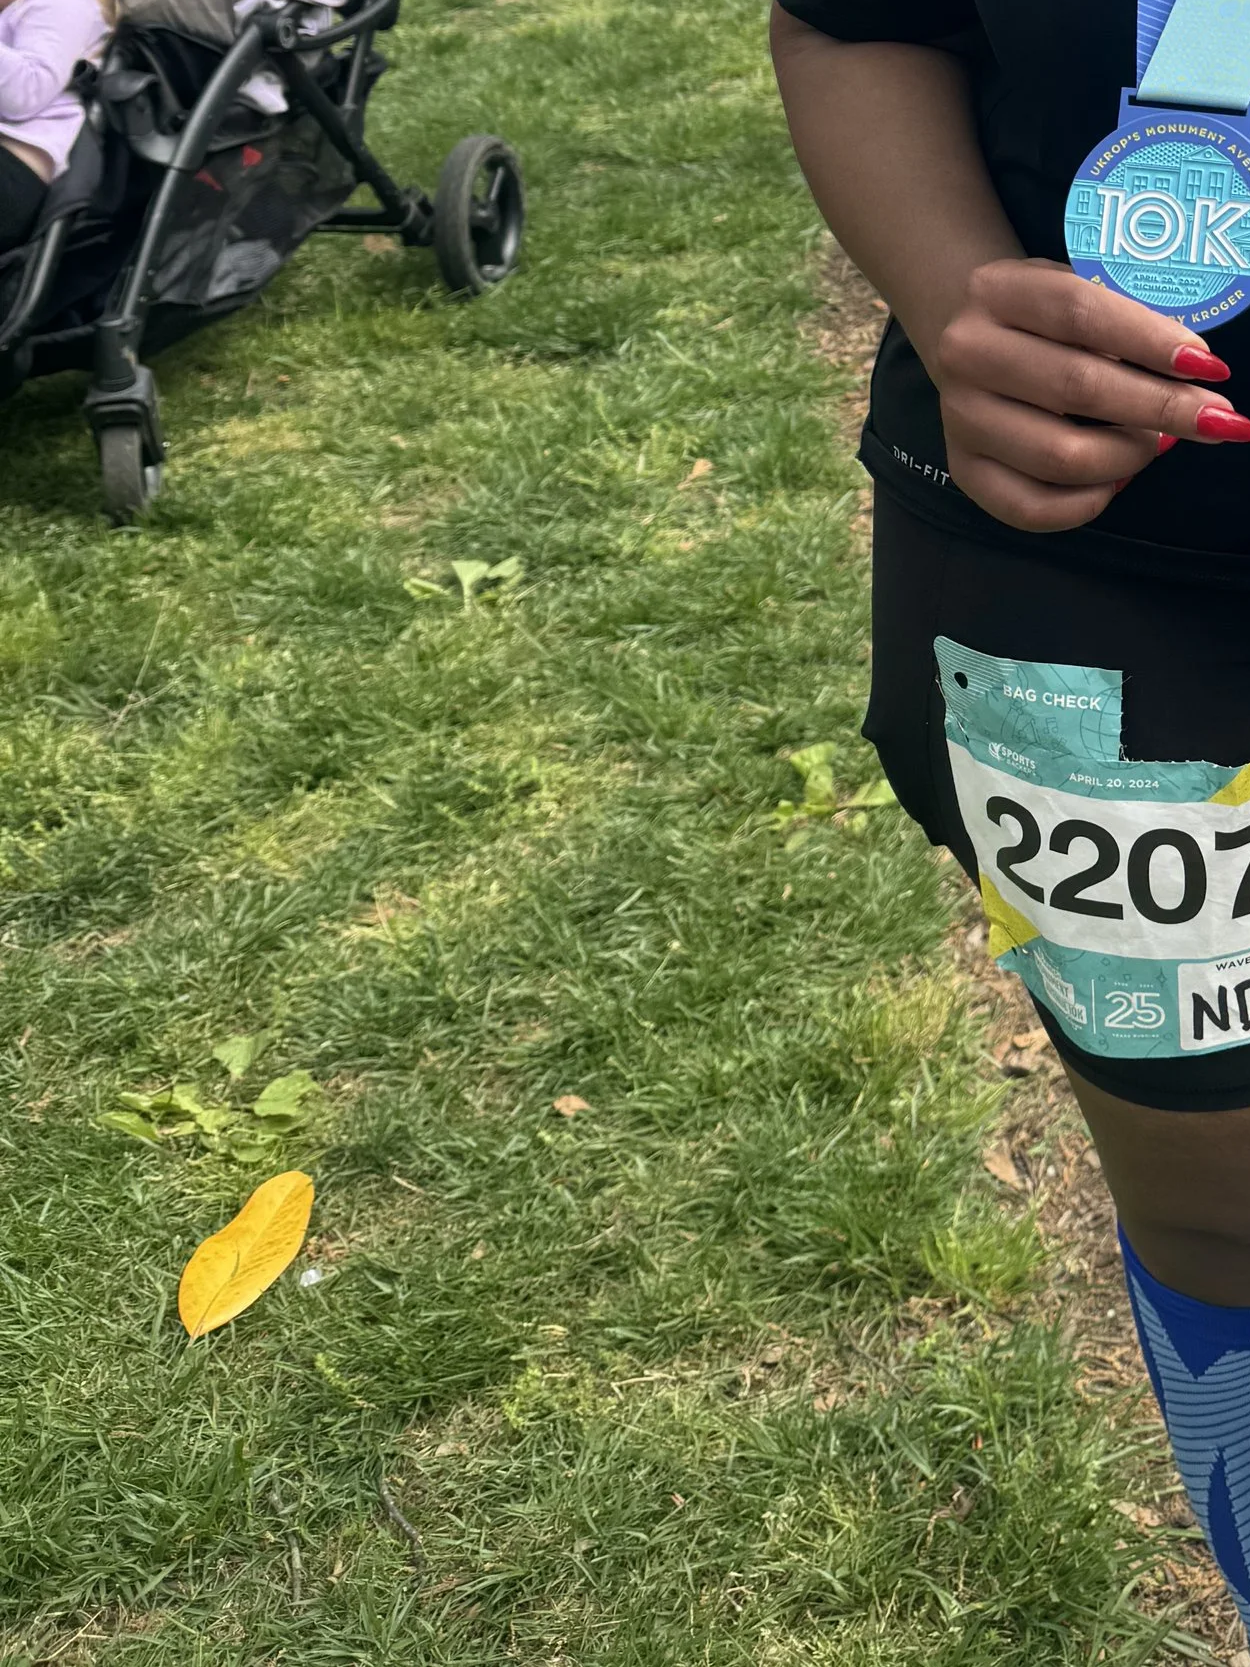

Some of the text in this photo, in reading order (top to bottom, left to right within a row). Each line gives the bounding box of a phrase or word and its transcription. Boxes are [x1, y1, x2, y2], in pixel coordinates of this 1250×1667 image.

[1090, 131, 1142, 177] UKROP'S
[1145, 123, 1227, 146] MONUMENT
[1132, 273, 1159, 283] APRIL
[1191, 289, 1246, 324] KROGER
[893, 445, 950, 486] DRI-FIT
[1003, 683, 1102, 711] BAG CHECK
[1001, 745, 1037, 770] SPORTS
[1069, 772, 1160, 789] APRIL 20, 2024
[1104, 990, 1166, 1029] 25
